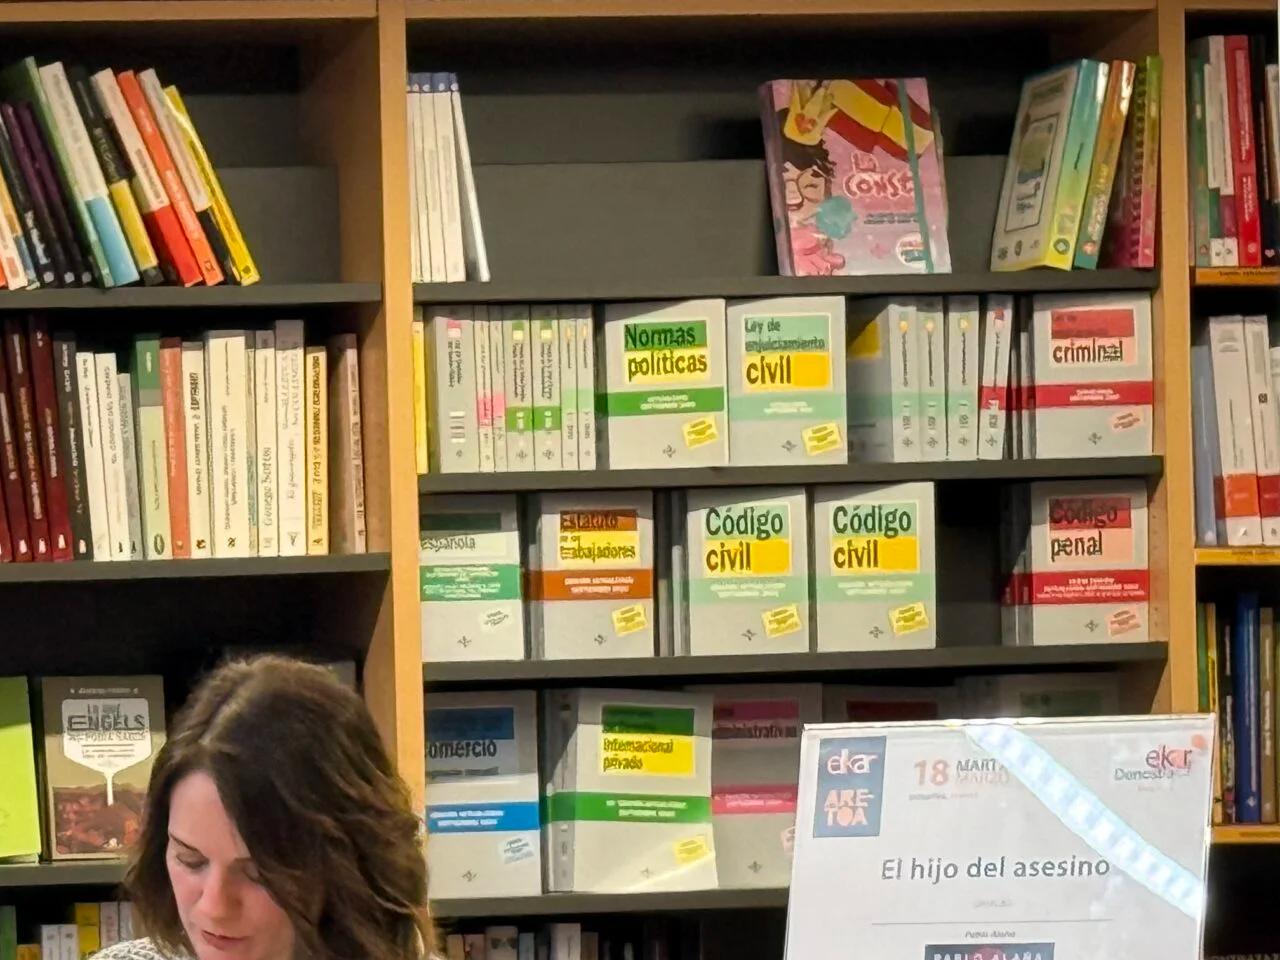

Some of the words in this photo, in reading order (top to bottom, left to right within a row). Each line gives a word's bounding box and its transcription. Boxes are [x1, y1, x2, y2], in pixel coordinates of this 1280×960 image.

[625, 323, 696, 349] Normas
[744, 319, 765, 336] Ley
[768, 319, 781, 332] de
[1053, 338, 1123, 363] criminal
[746, 355, 792, 385] civil
[706, 506, 783, 540] Código
[833, 504, 912, 538] Código
[706, 540, 751, 573] civil
[833, 539, 879, 569] civil
[1051, 530, 1103, 562] penal
[914, 759, 951, 786] 18
[881, 857, 902, 880] El
[910, 857, 958, 885] hijo
[966, 856, 1006, 878] del
[1013, 855, 1111, 878] asesino
